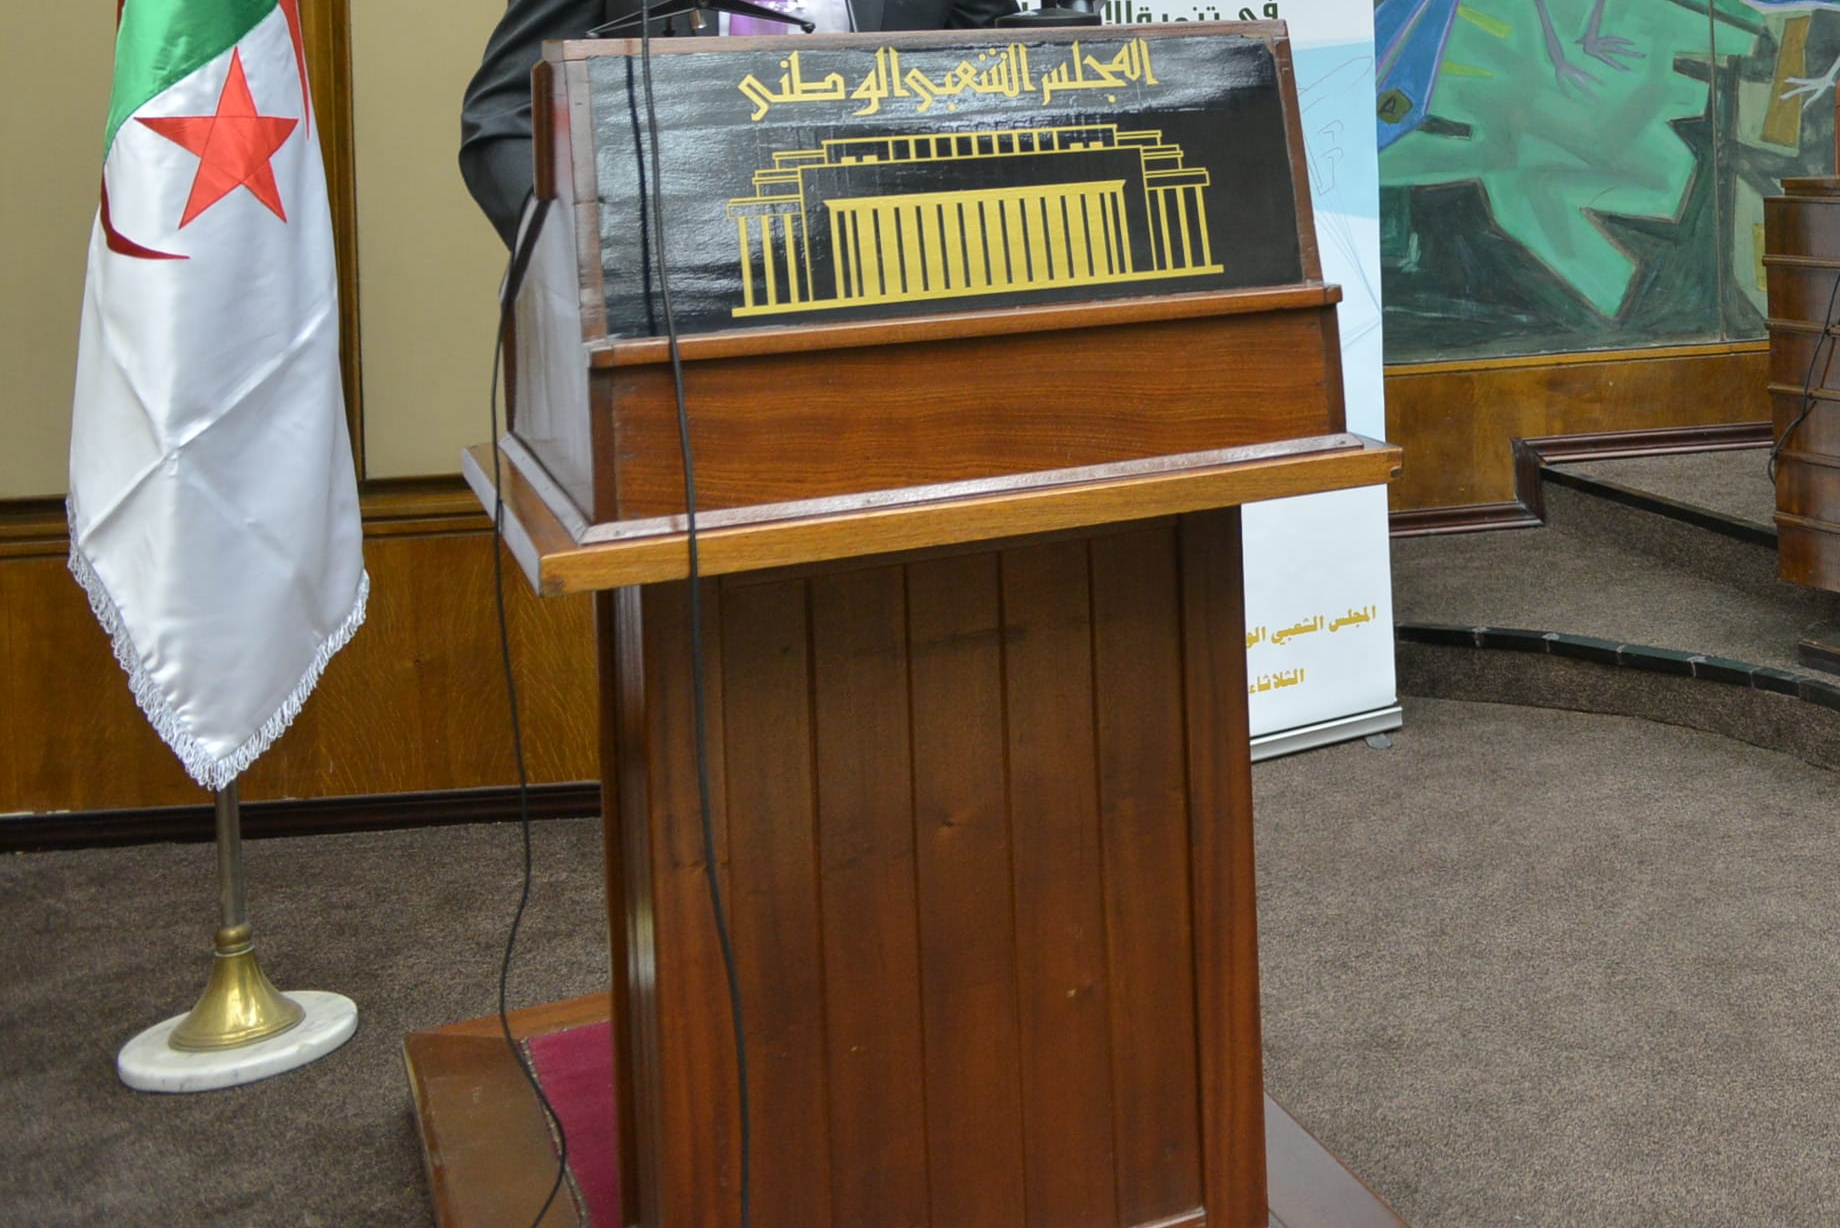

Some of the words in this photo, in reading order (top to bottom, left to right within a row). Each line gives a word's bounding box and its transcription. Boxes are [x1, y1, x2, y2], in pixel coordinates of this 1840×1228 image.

[735, 46, 909, 120] الوطني
[903, 42, 1036, 115] الشعبي
[1040, 37, 1159, 106] المجلس
[1270, 615, 1324, 646] الشعبي
[1328, 605, 1376, 633] المجلس
[1246, 627, 1267, 649] الو
[1248, 668, 1305, 695] الثلاثاء
